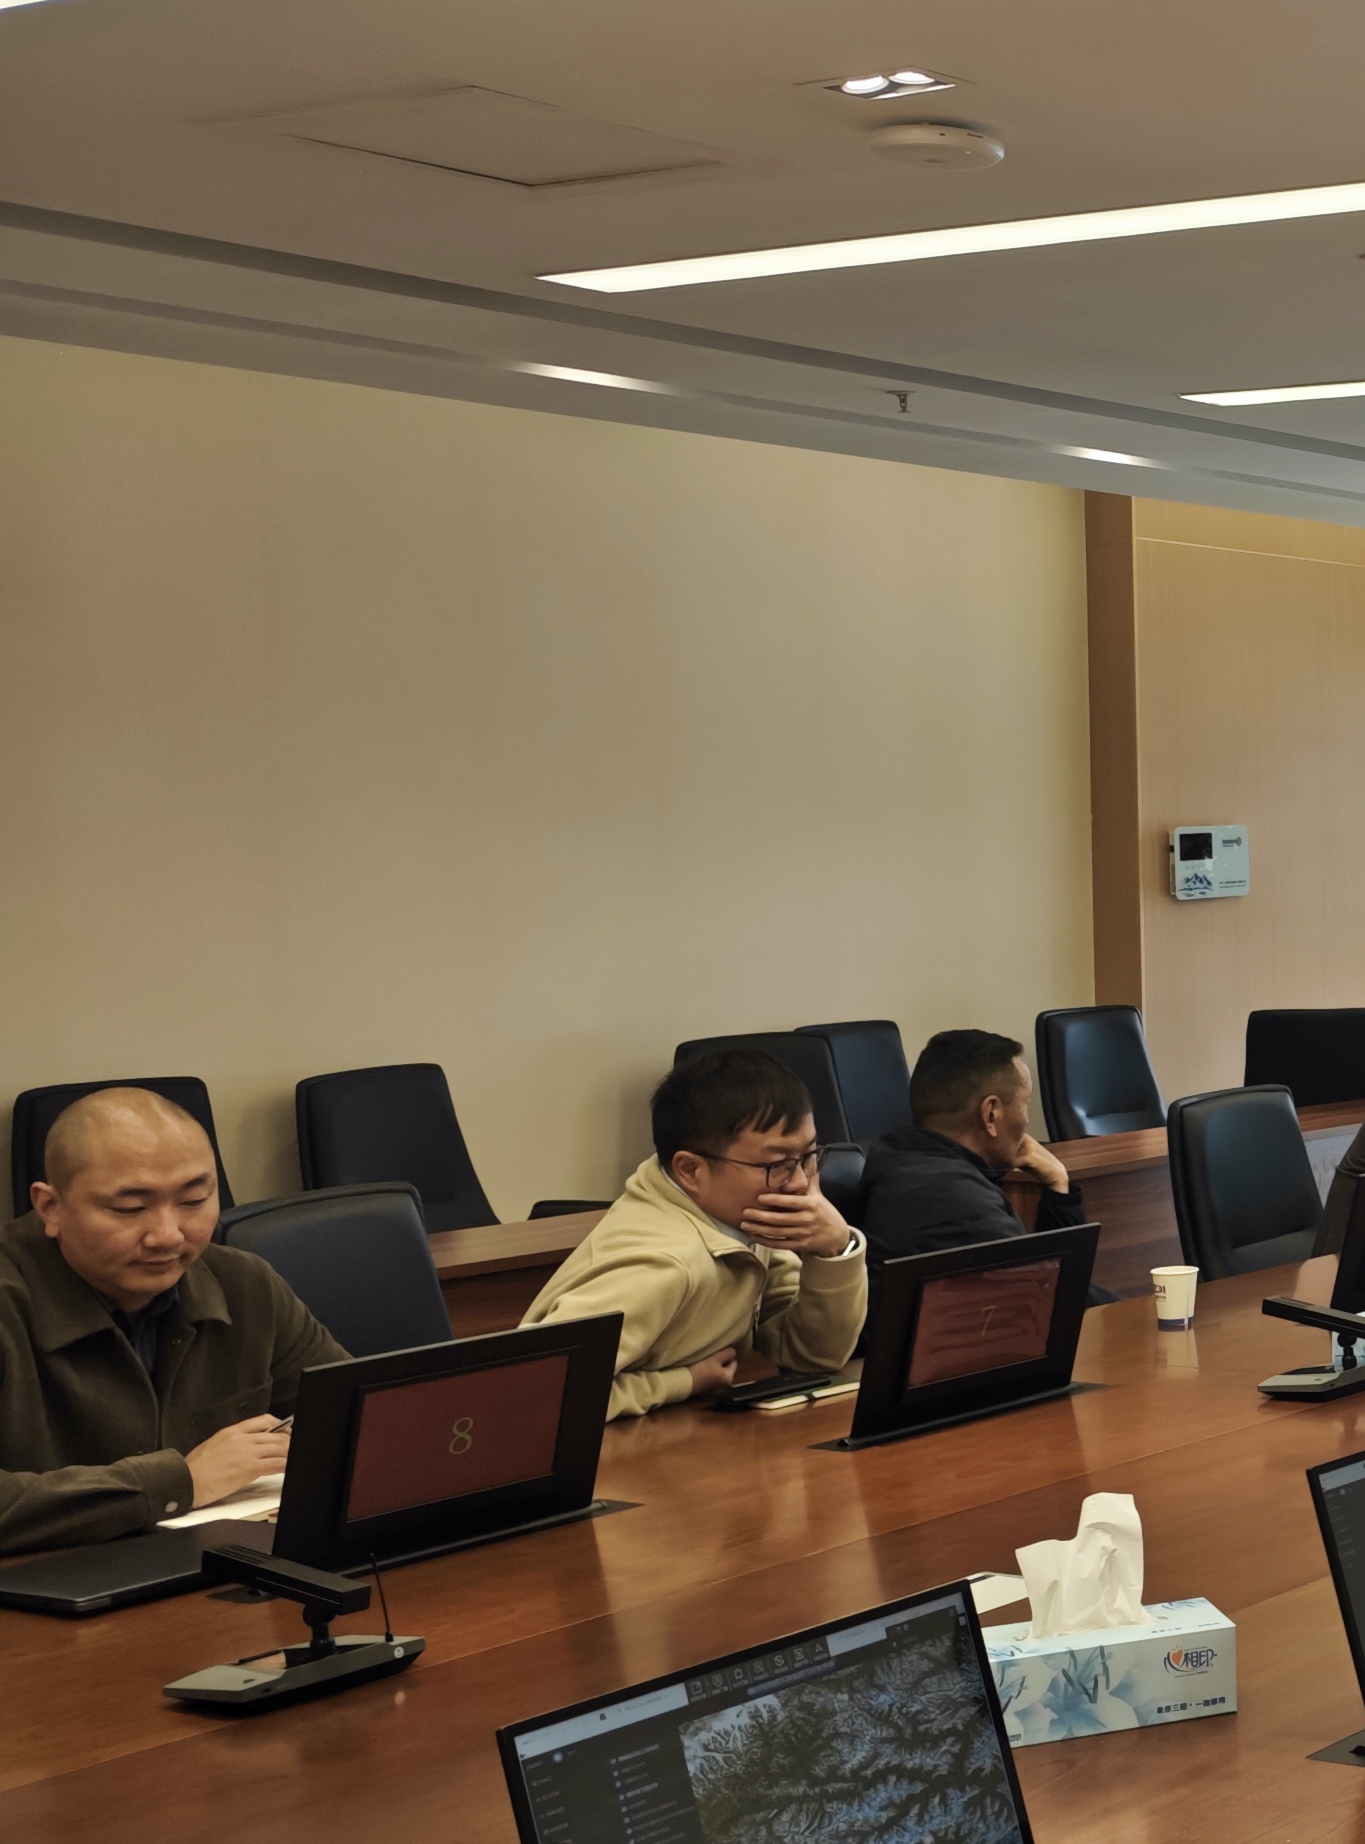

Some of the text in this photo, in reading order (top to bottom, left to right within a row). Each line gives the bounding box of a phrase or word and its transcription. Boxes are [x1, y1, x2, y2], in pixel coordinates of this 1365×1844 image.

[981, 1304, 998, 1337] 7
[448, 1416, 474, 1455] 8
[1163, 1646, 1218, 1674] 心相印
